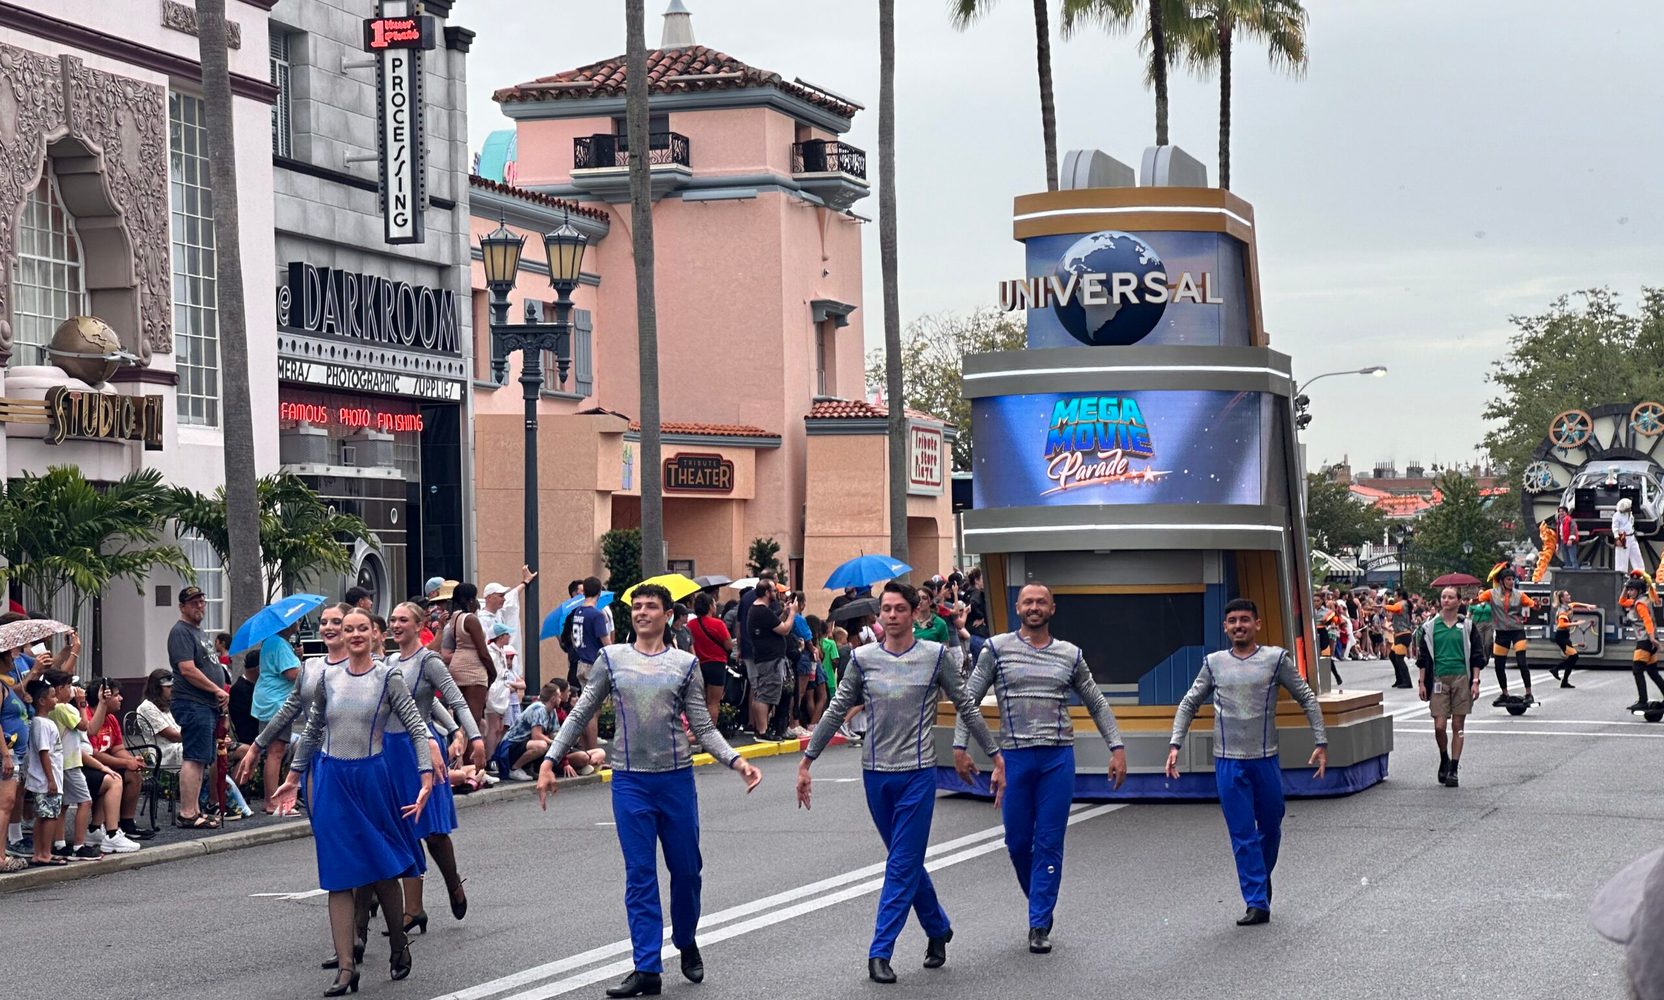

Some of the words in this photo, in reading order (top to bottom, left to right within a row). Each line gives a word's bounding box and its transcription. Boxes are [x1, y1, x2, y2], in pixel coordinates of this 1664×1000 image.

[370, 20, 388, 48] 1
[390, 57, 409, 228] PROCESSING
[998, 271, 1224, 312] UNIVERSAL
[303, 263, 461, 354] DARKROOM
[326, 365, 401, 394] PHOTOGRAPHIC
[413, 377, 455, 400] SUPPLIES
[281, 402, 328, 424] FAMOUS
[339, 407, 371, 428] PHOTO
[377, 412, 424, 432] FINISHING
[1049, 396, 1147, 429] MEGA
[915, 431, 938, 452] Tribute
[1044, 422, 1155, 459] MOVIE
[683, 459, 718, 467] TRIBUTE
[915, 455, 933, 483] Plaza
[920, 450, 938, 467] Store
[1047, 448, 1129, 486] Parade
[667, 464, 731, 488] THEATER
